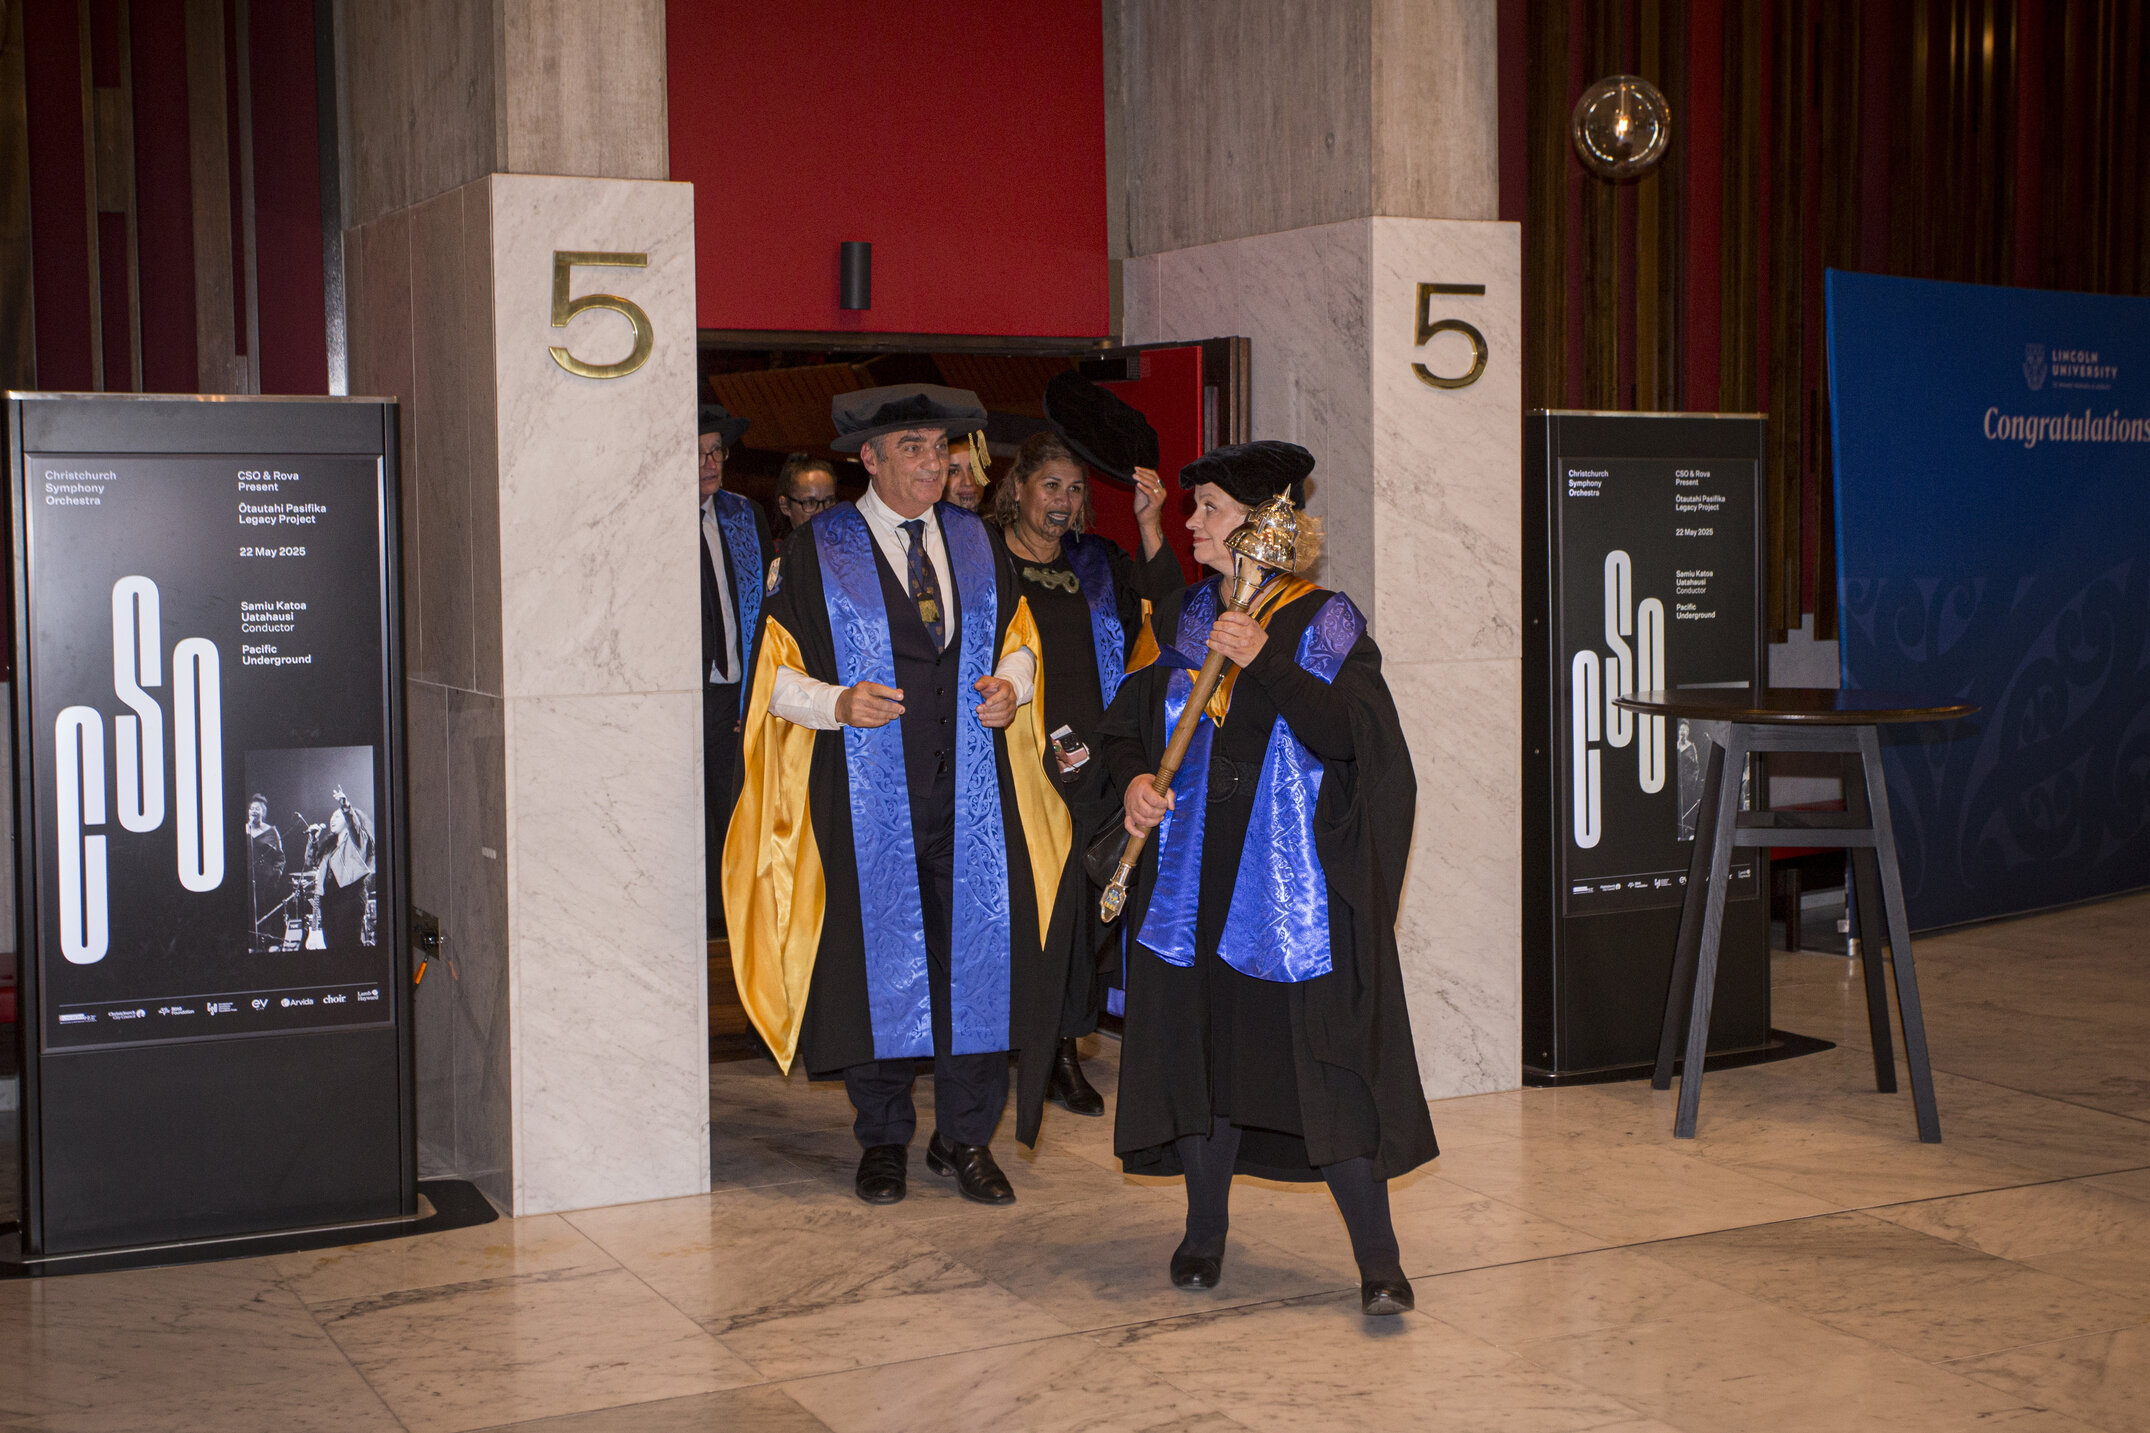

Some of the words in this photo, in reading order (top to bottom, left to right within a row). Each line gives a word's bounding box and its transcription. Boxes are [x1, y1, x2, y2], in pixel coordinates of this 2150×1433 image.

[549, 250, 654, 379] 5
[1411, 282, 1488, 389] 5
[2052, 349, 2098, 363] LINCOLN
[2052, 364, 2118, 378] UNIVERSITY
[1984, 406, 2150, 449] Congratulations
[45, 470, 117, 481] Christchurch
[237, 470, 261, 481] CSO
[262, 470, 272, 481] &
[273, 470, 299, 481] Rova
[1568, 470, 1609, 478] Christchurch
[1675, 470, 1689, 478] CSO
[1689, 470, 1695, 478] &
[1695, 470, 1711, 478] Rova
[238, 482, 279, 492] Present
[1568, 479, 1602, 488] Symphony
[1675, 478, 1699, 486] Present
[45, 482, 105, 495] Symphony
[1568, 488, 1600, 497] Orchestra
[45, 495, 101, 506] Orchestra
[1702, 494, 1726, 503] Pasifika
[286, 503, 327, 514] Pasifika
[1675, 503, 1698, 512] Legacy
[1698, 503, 1719, 512] Project
[239, 514, 277, 526] Legacy
[278, 514, 316, 526] Project
[1675, 528, 1684, 536] 22
[1684, 528, 1698, 537] May
[1698, 528, 1713, 536] 2025
[239, 547, 253, 557] 22
[255, 547, 277, 559] May
[279, 546, 306, 557] 2025
[1676, 587, 1707, 595] Conductor
[241, 601, 274, 611] Samiu
[276, 600, 307, 611] Katoa
[241, 612, 294, 622] Uatahausi
[1676, 610, 1716, 620] Underground
[242, 623, 295, 633] Conductor
[242, 644, 277, 655] Pacific
[242, 654, 312, 667] Underground
[290, 998, 314, 1007] Arvida
